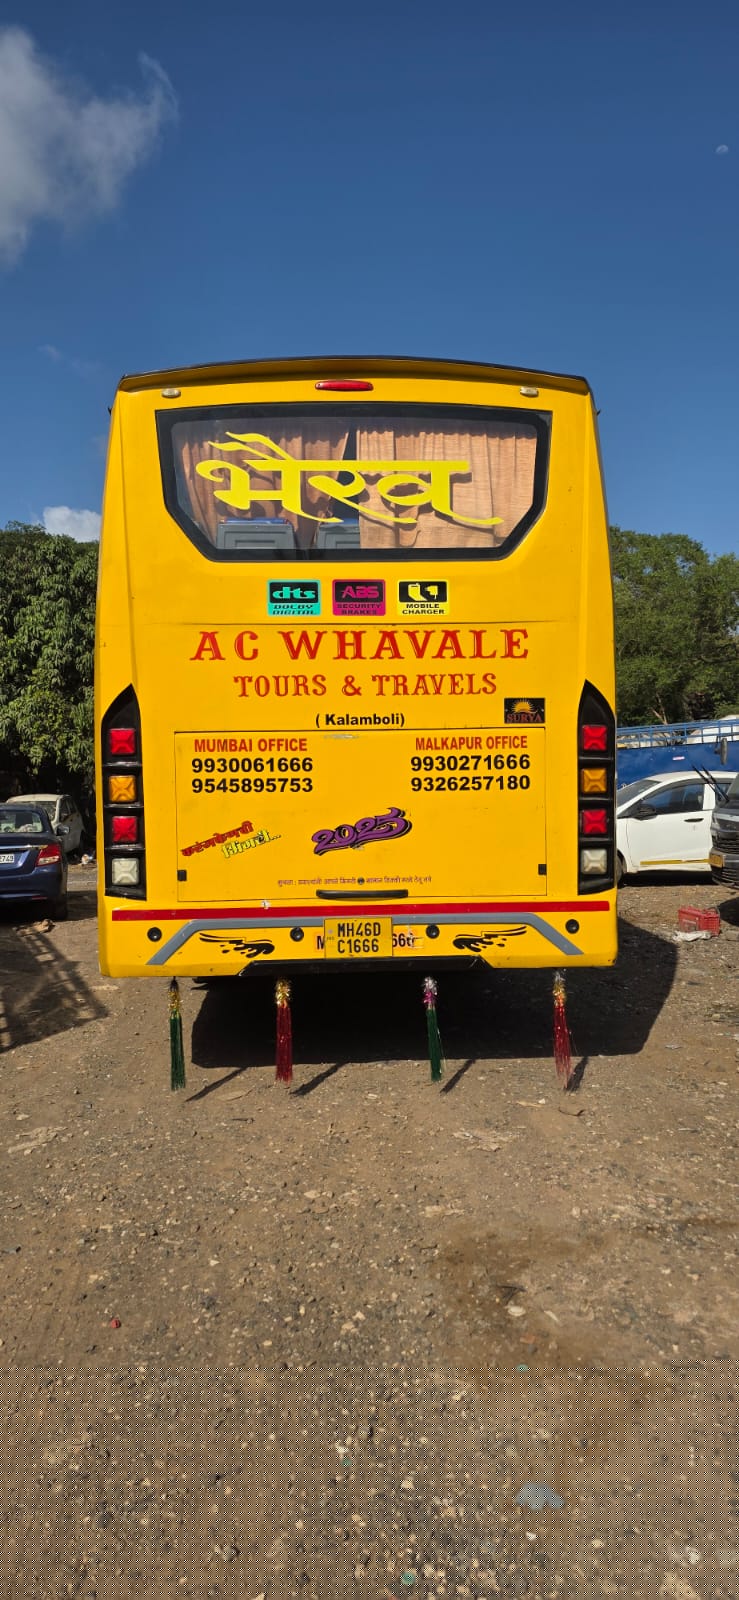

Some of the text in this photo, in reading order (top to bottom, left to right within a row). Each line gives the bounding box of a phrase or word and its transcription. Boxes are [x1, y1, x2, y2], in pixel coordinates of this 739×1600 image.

[195, 431, 504, 525] भैरव
[341, 585, 380, 599] ABS
[277, 628, 529, 661] WHAVALE
[233, 673, 497, 698] TOURS & TRAVELS
[506, 713, 542, 724] SURYA
[193, 737, 308, 753] MUMBAI OFFICE
[415, 735, 528, 751] MALKAPUR OFFICE
[191, 757, 313, 773] 9930061666
[410, 754, 531, 771] 9930271666
[191, 778, 313, 793] 9545895753
[410, 775, 531, 791] 9326257180
[337, 922, 381, 938] MH46D
[337, 938, 379, 954] C1666
